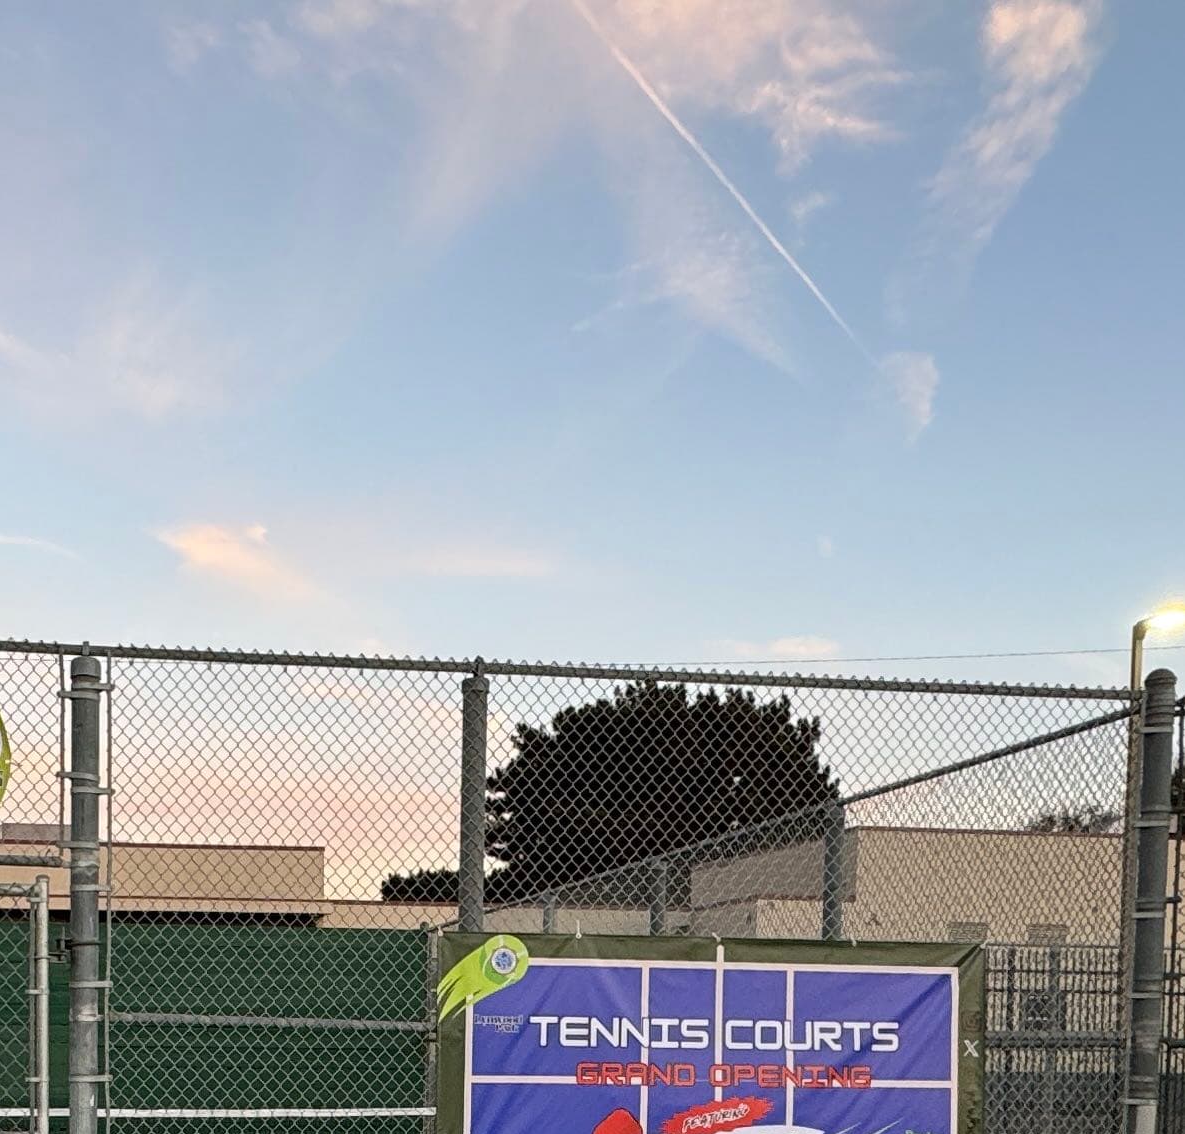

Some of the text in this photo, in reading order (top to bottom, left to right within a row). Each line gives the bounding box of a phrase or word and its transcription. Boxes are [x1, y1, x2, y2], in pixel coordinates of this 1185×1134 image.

[528, 1015, 900, 1053] TENNIS COURTS
[576, 1061, 872, 1089] GRAND OPENING
[681, 1103, 751, 1133] FEATURING
